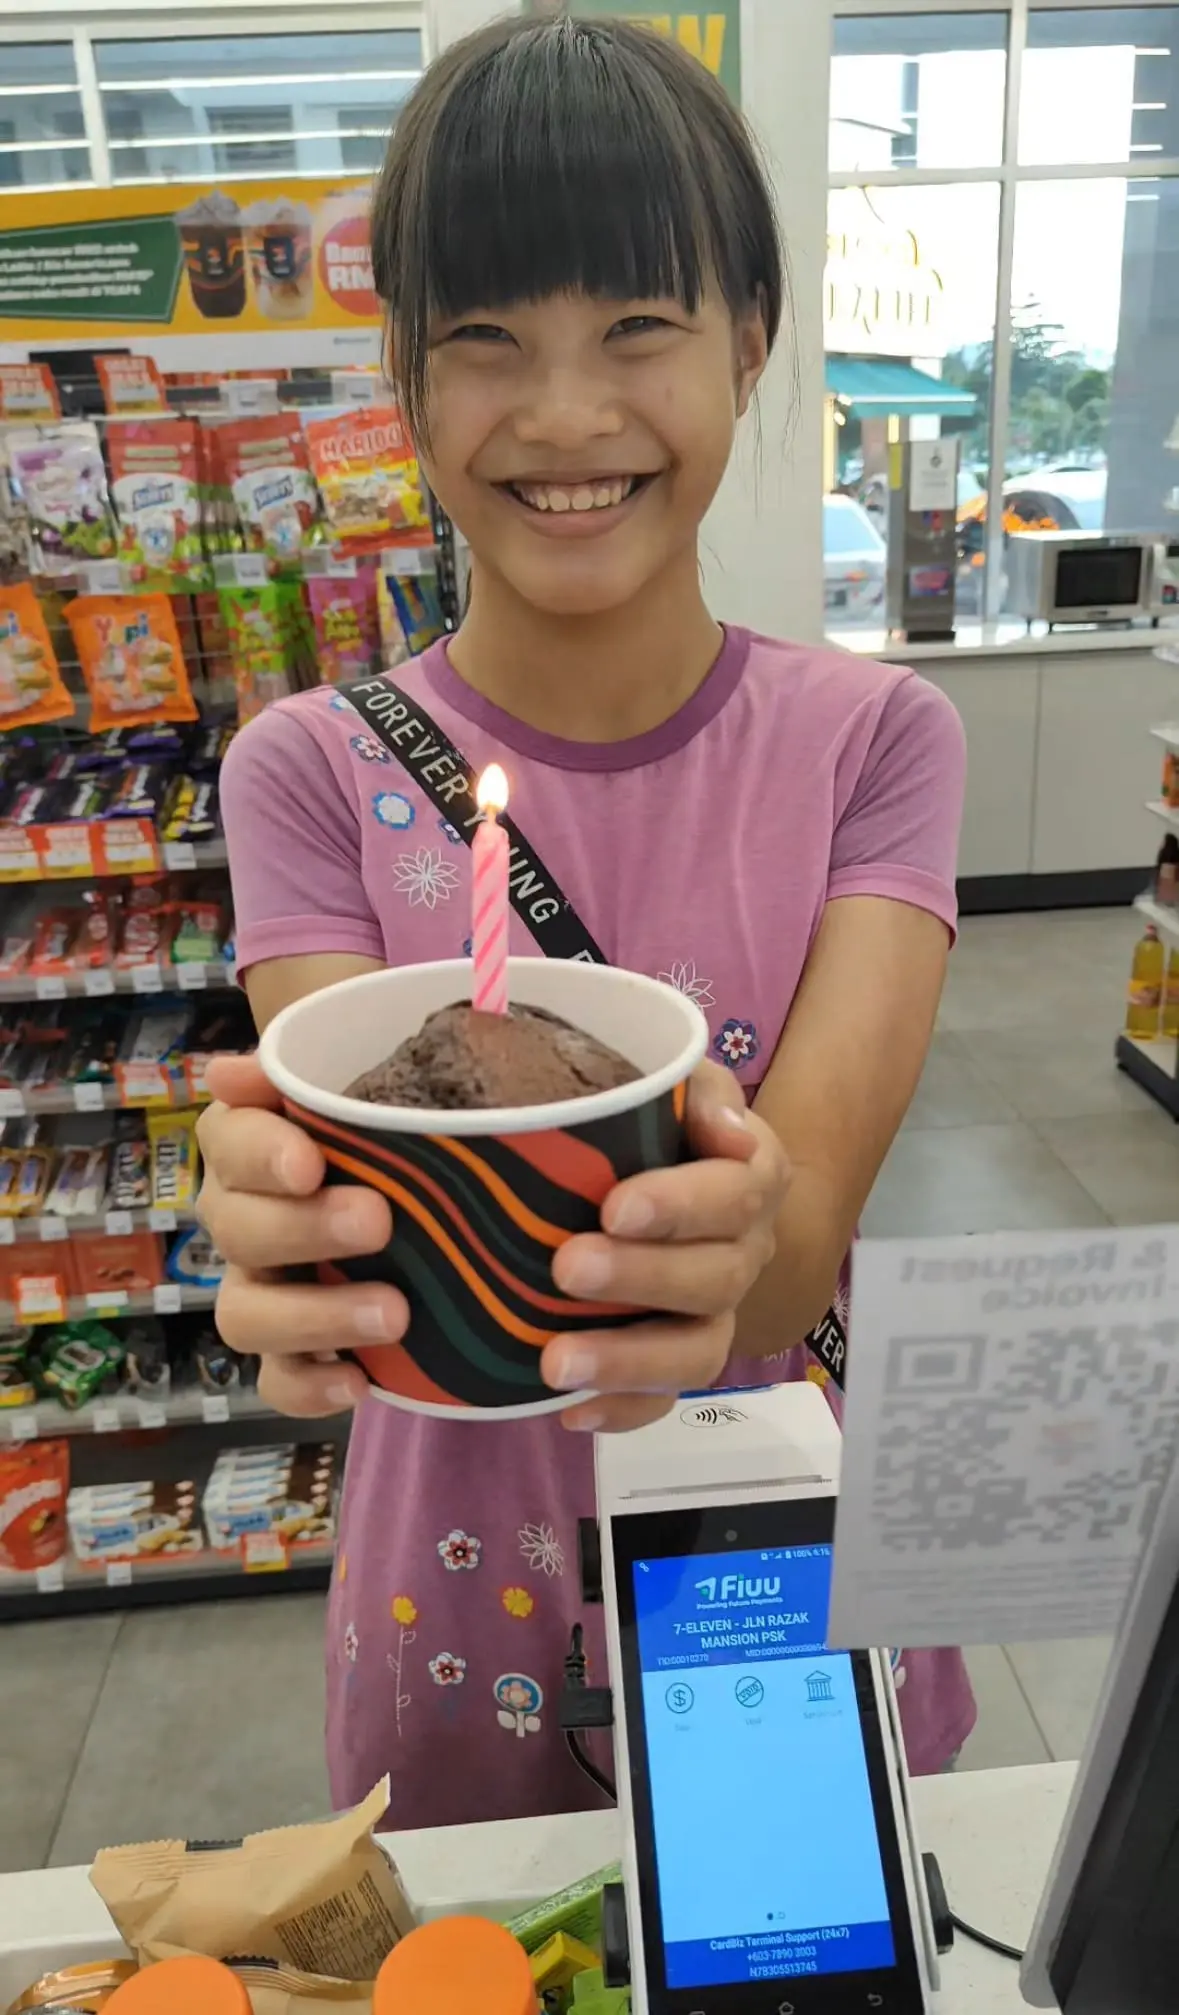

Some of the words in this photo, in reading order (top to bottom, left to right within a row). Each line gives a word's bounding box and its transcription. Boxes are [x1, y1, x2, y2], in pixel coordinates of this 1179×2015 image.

[320, 421, 402, 463] HARIBO
[351, 680, 470, 804] FOREVER
[721, 1574, 781, 1600] Fiuu
[673, 1619, 732, 1635] 7-ELEVEN
[742, 1616, 766, 1629] JLN
[768, 1612, 810, 1627] RAZAK
[701, 1632, 759, 1649] MANSION
[761, 1630, 787, 1643] PSK
[747, 1933, 784, 1947] Terminal
[786, 1929, 820, 1945] Support
